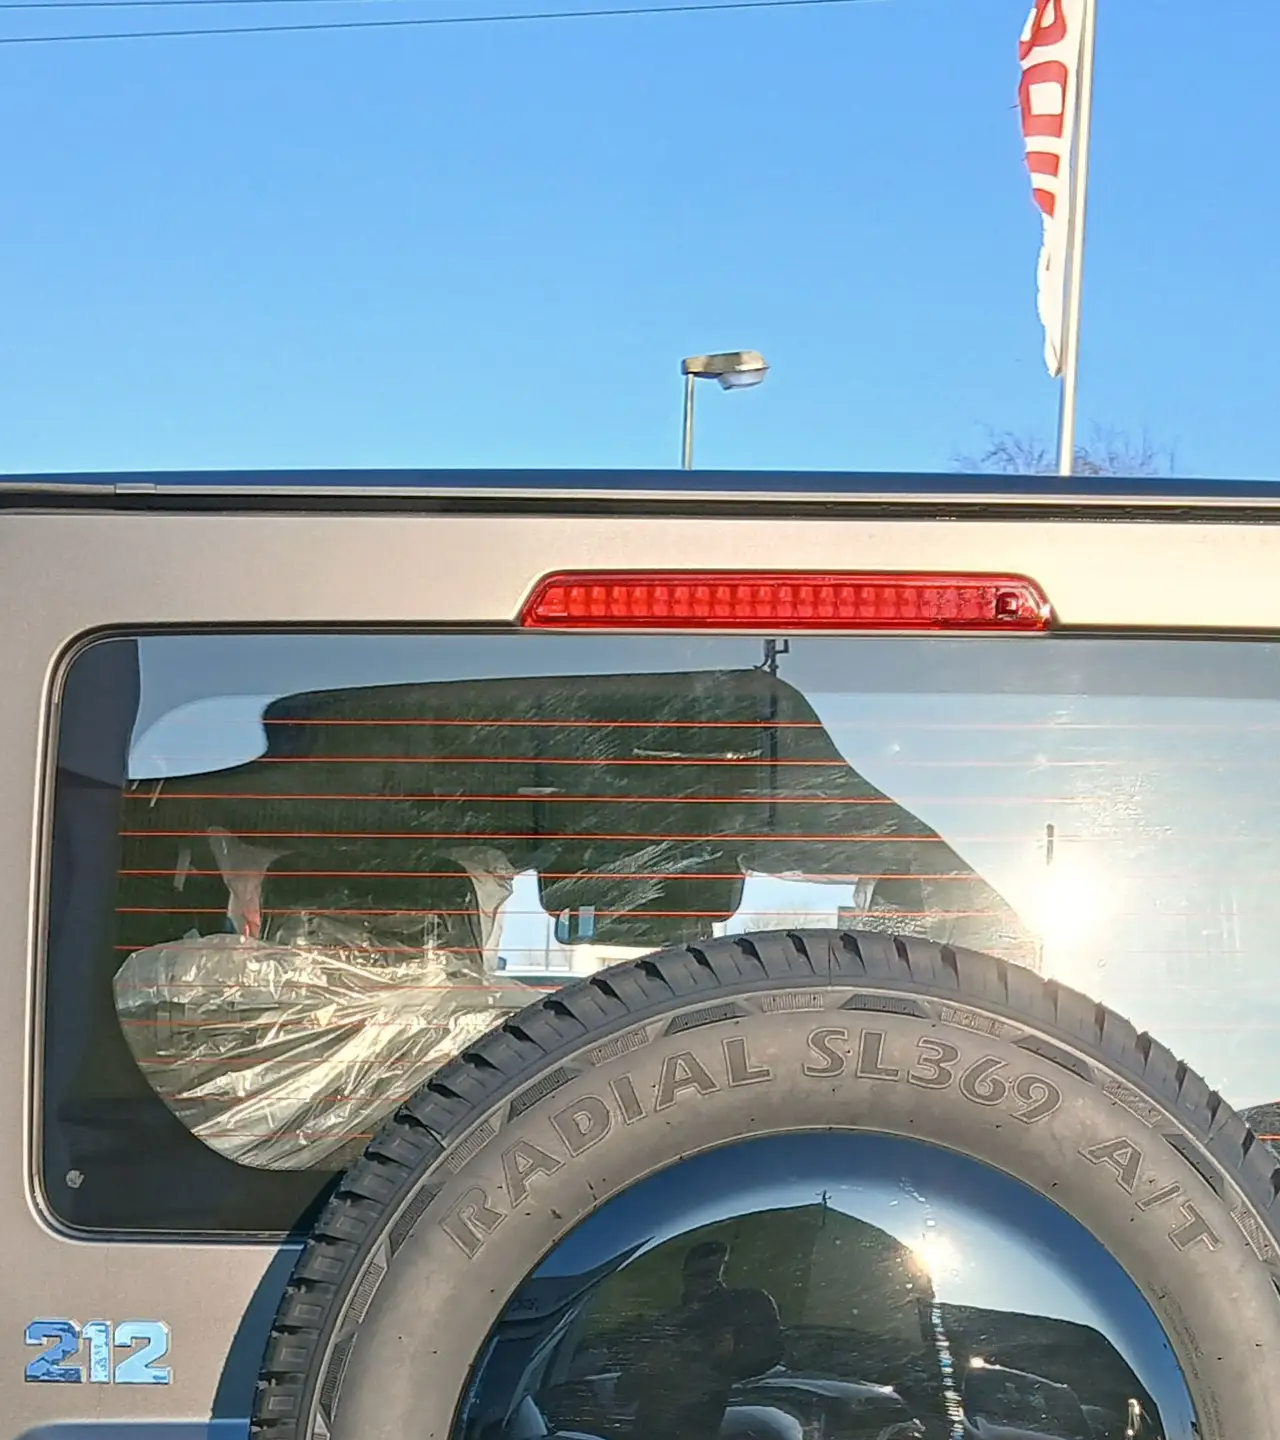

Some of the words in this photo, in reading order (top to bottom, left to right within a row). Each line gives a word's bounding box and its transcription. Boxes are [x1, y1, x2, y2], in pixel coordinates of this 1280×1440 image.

[440, 1036, 773, 1260] RADIAL
[801, 1027, 1063, 1126] SL369
[1077, 1135, 1222, 1252] A/T
[23, 1316, 173, 1386] 212
